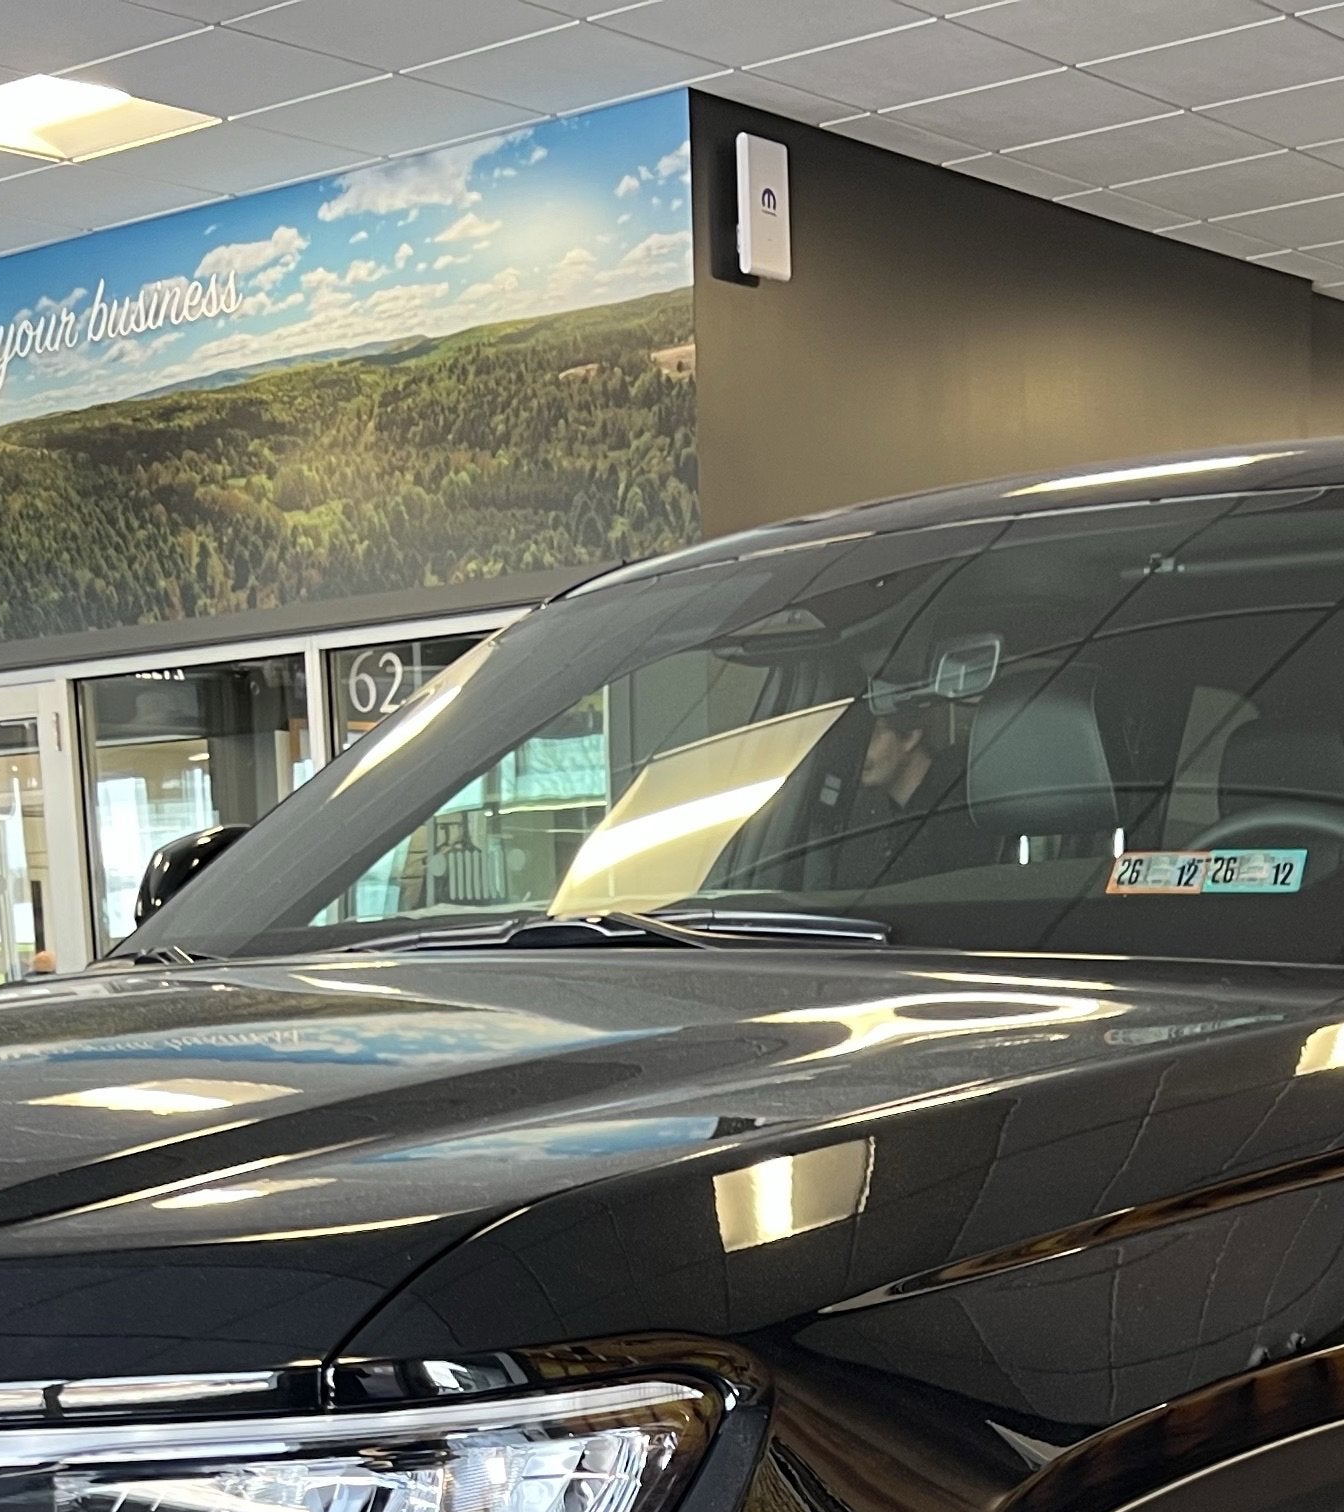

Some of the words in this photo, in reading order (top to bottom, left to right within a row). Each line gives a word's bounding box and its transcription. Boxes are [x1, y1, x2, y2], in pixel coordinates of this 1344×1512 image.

[87, 269, 244, 343] business
[348, 650, 408, 714] 62
[1116, 858, 1144, 886] 26
[1175, 862, 1199, 887] 12
[1211, 856, 1237, 884] 26
[1271, 861, 1295, 886] 12
